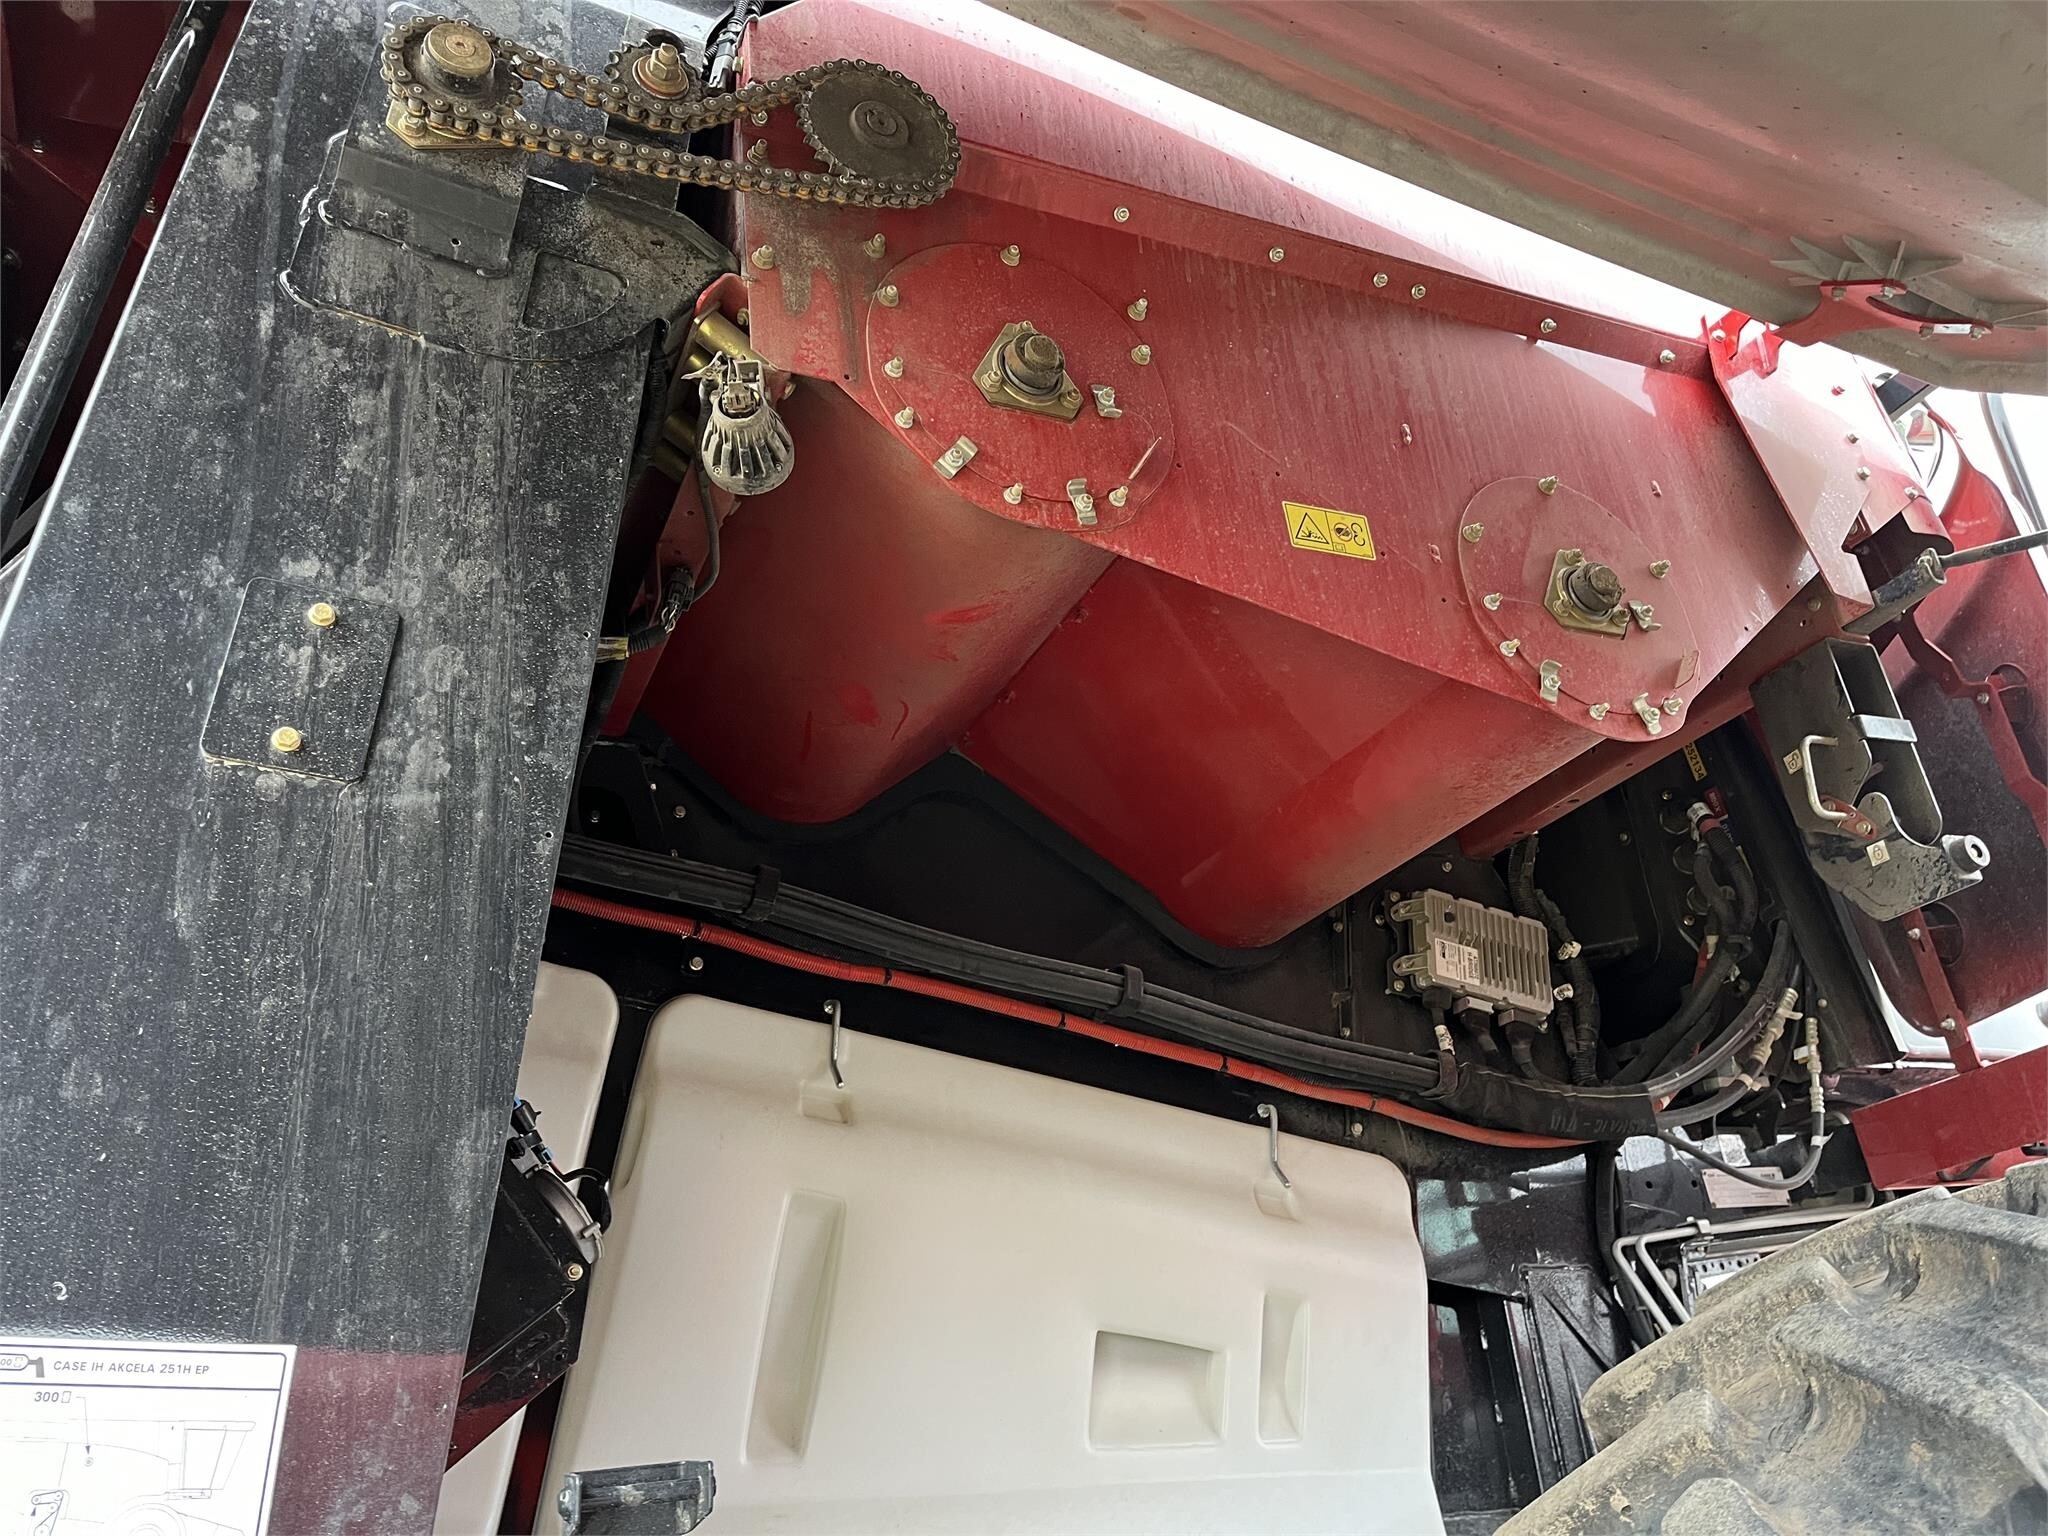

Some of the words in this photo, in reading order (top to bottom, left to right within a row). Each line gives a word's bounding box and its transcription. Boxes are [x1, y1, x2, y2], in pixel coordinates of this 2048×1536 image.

[53, 1360, 87, 1371] CASE
[91, 1361, 103, 1372] IH
[108, 1362, 155, 1374] AKCELA
[159, 1363, 192, 1375] 251H
[195, 1364, 209, 1375] EP
